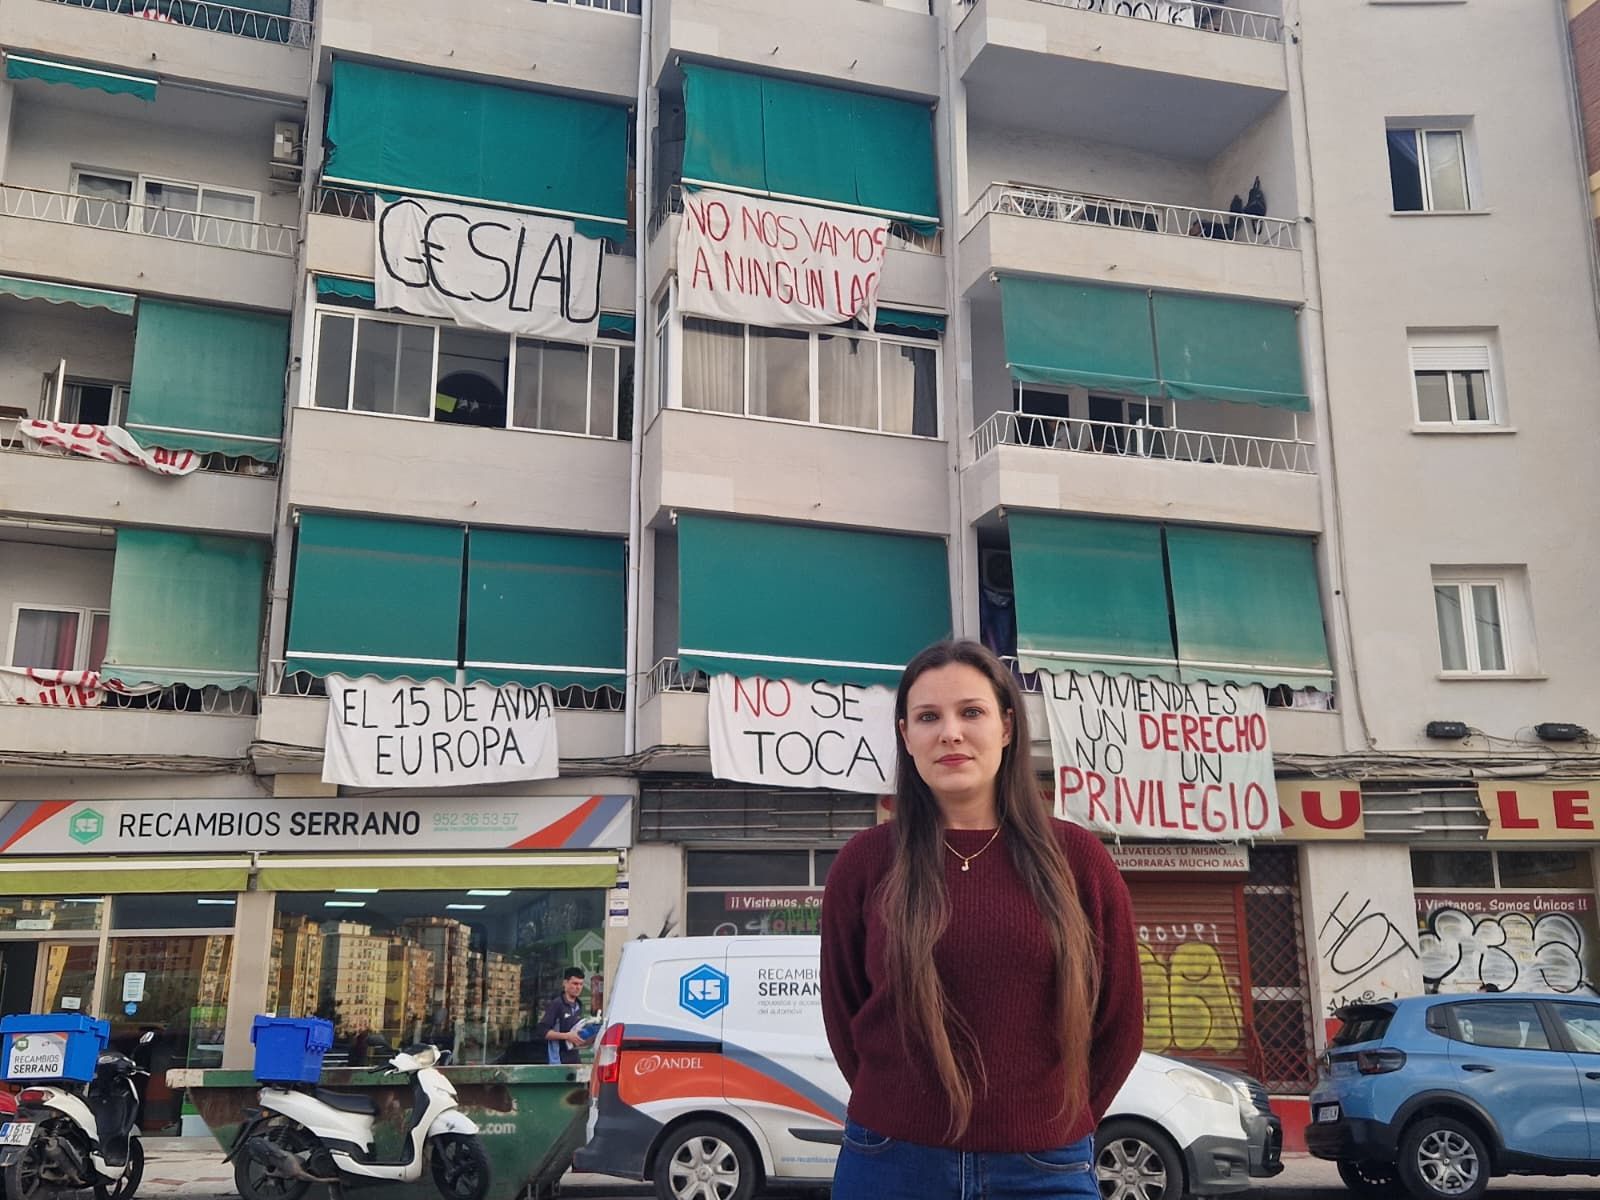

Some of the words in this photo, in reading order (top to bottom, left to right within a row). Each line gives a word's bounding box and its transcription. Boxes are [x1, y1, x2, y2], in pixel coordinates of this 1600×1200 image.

[688, 200, 731, 242] NO
[741, 205, 798, 251] NOS
[692, 246, 714, 292] A
[723, 250, 826, 311] NINGÚN
[343, 688, 379, 729] EL
[391, 686, 430, 728] 15
[444, 687, 478, 723] DE
[490, 685, 551, 723] AVDA
[733, 676, 792, 718] NO
[810, 678, 867, 722] SE
[1051, 672, 1084, 702] LA
[1088, 674, 1199, 714] VIVIENDA
[1204, 682, 1240, 716] ES
[376, 726, 526, 776] EUROPA
[1079, 705, 1128, 746] UN
[1138, 712, 1268, 753] DERECHO
[743, 730, 887, 782] TOCA
[1075, 737, 1124, 775] NO
[1180, 752, 1223, 784] UN
[433, 813, 458, 826] 952
[462, 813, 479, 826] 36
[482, 813, 500, 826] 53
[502, 812, 519, 826] 57
[1059, 766, 1270, 833] PRIVILEGIO
[118, 811, 282, 838] RECAMBIOS
[288, 810, 421, 836] SERRANO
[1178, 858, 1220, 868] MUCHO
[1489, 898, 1531, 911] Somos
[1533, 896, 1575, 911] Únicos
[758, 968, 820, 981] RECAMBI
[758, 982, 821, 997] SERRAN
[13, 1063, 58, 1074] SERRANO
[14, 1054, 60, 1064] RECAMBIOS
[662, 1057, 704, 1070] ANDEL
